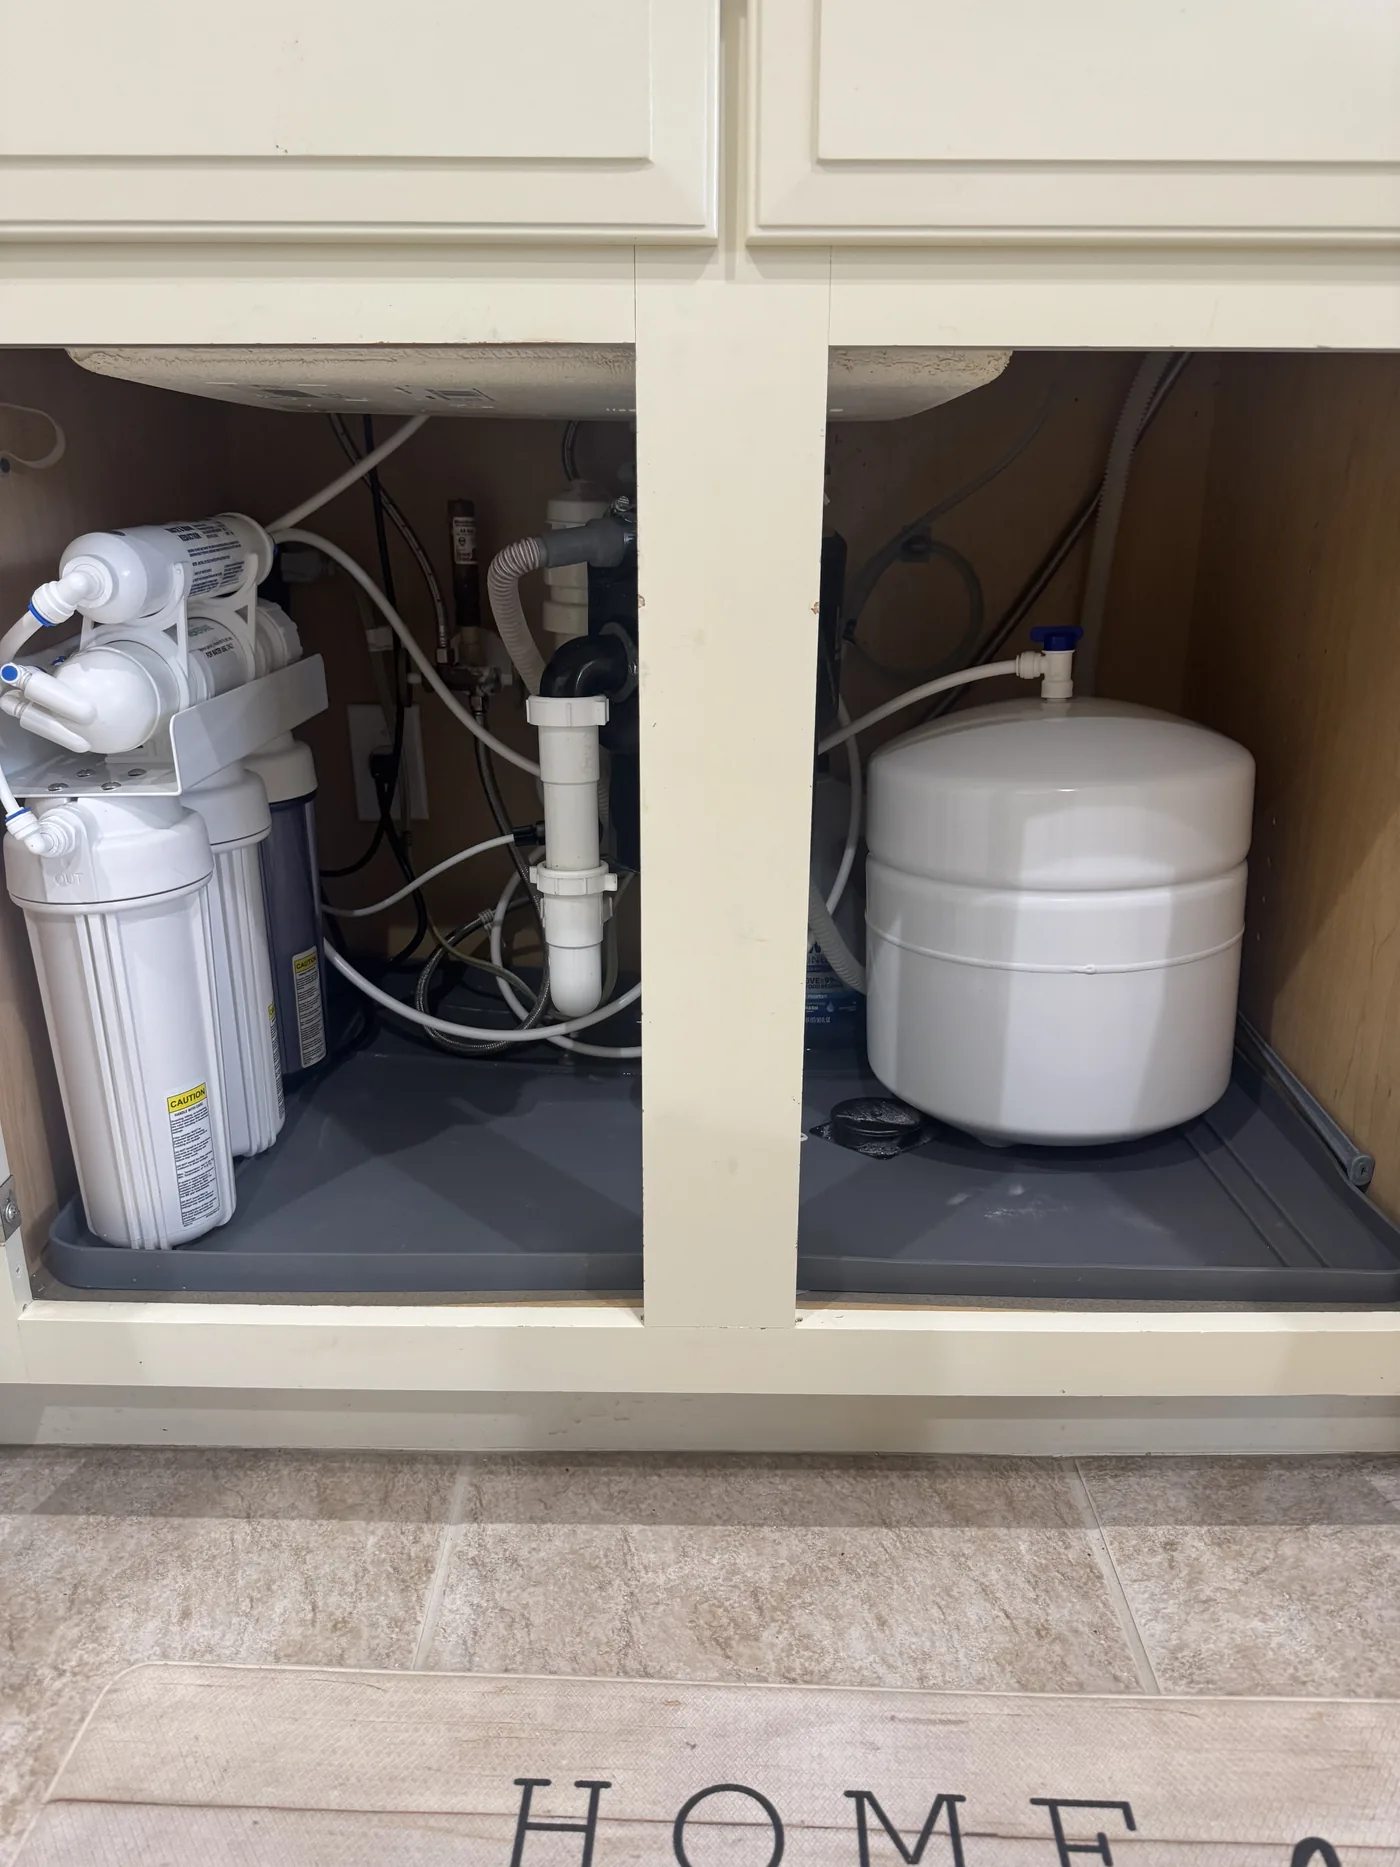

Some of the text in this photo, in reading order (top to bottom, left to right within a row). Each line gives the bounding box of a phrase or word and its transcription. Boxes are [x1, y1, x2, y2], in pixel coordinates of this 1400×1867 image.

[54, 872, 83, 887] OUT
[170, 1088, 206, 1108] CAUTION
[512, 1777, 1138, 1867] HOME
